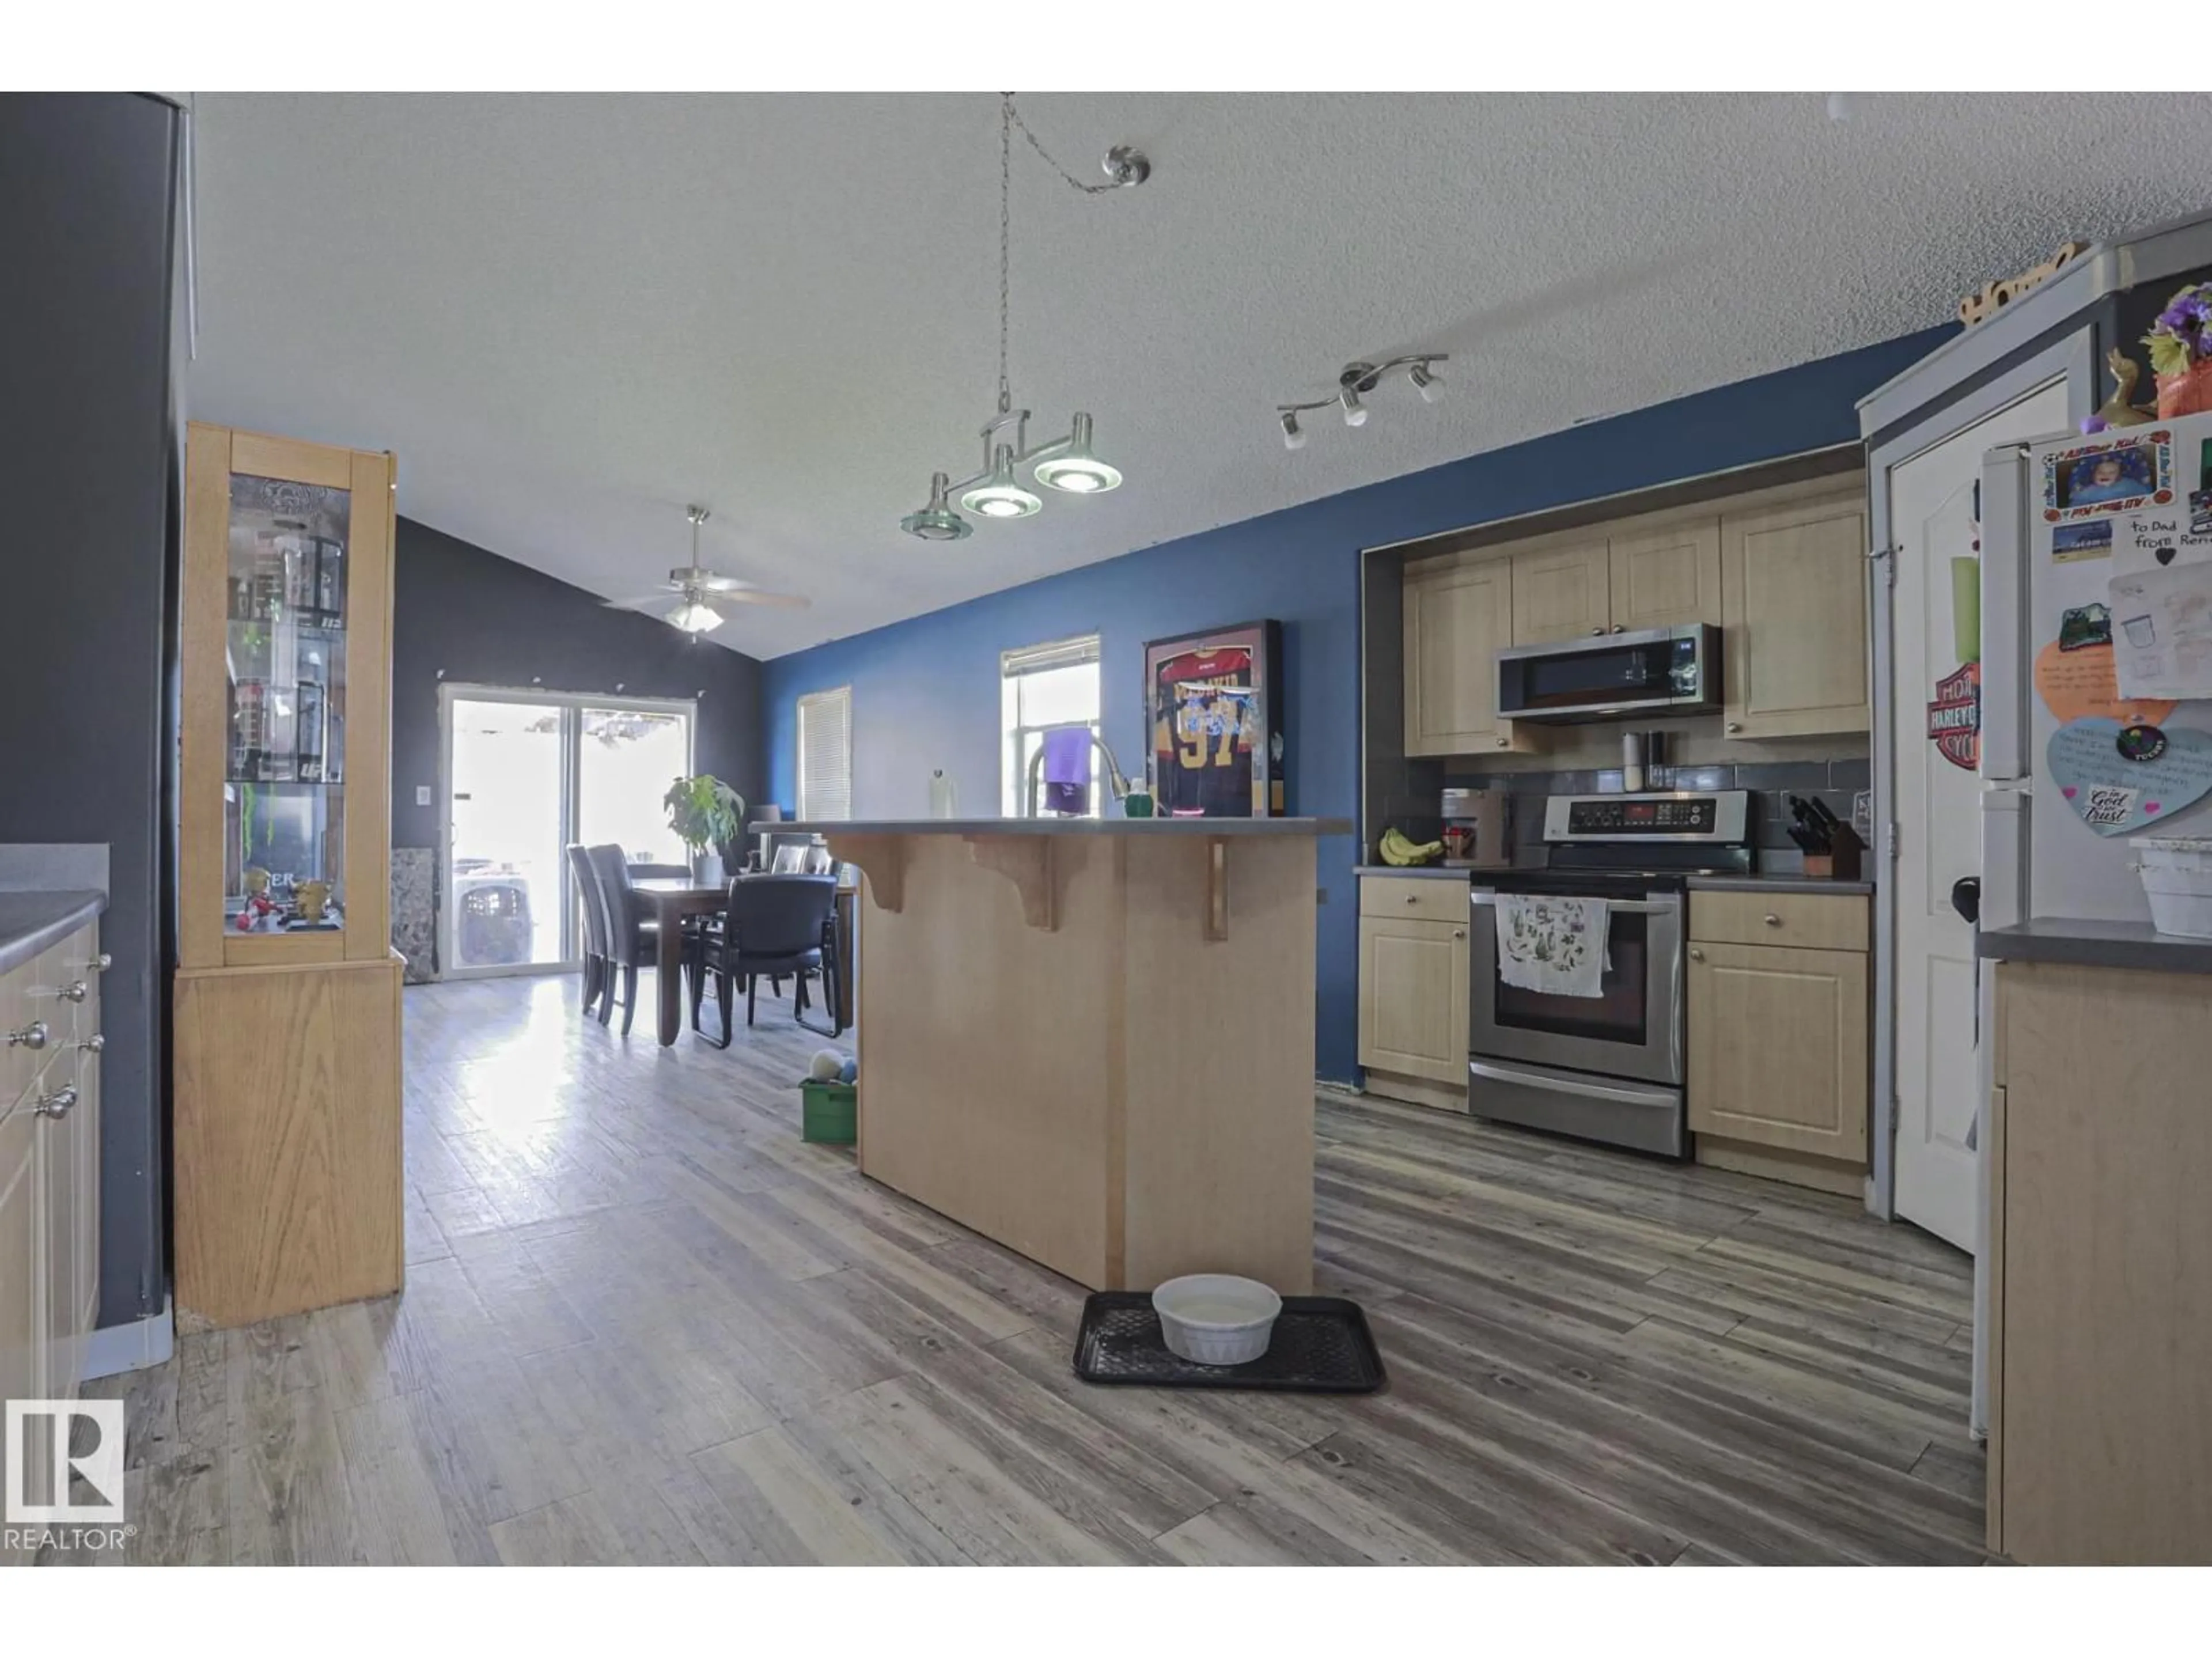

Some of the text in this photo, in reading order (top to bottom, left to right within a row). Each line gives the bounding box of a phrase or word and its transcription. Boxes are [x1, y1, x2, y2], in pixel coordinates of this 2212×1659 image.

[2152, 521, 2177, 532] Dad
[2135, 535, 2172, 548] from
[1179, 699, 1238, 769] 97
[2091, 789, 2129, 806] God
